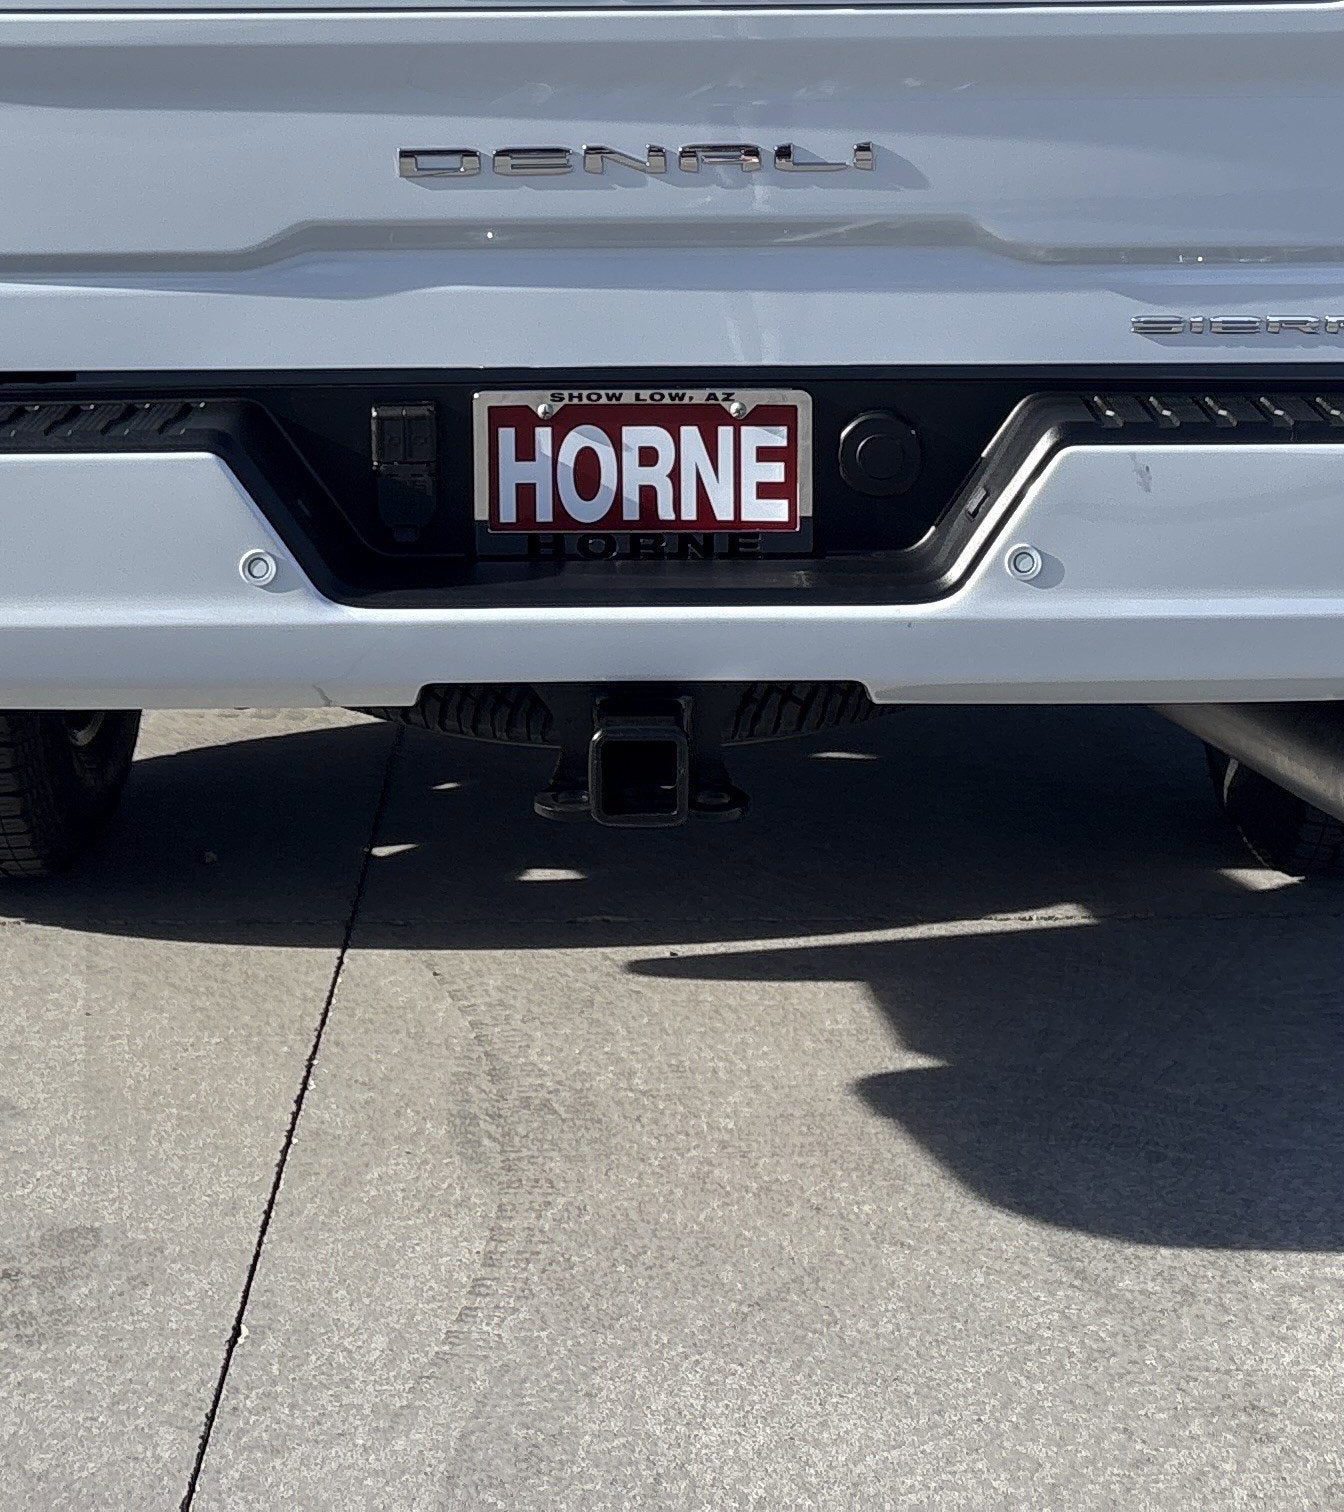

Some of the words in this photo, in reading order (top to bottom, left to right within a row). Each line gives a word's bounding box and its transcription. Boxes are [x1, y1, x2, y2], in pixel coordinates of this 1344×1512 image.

[397, 141, 877, 178] DENALI
[549, 391, 624, 403] SHOW
[634, 391, 694, 404] LOW,
[704, 391, 736, 402] AZ
[497, 424, 789, 524] HORNE
[527, 533, 763, 559] HORNE
